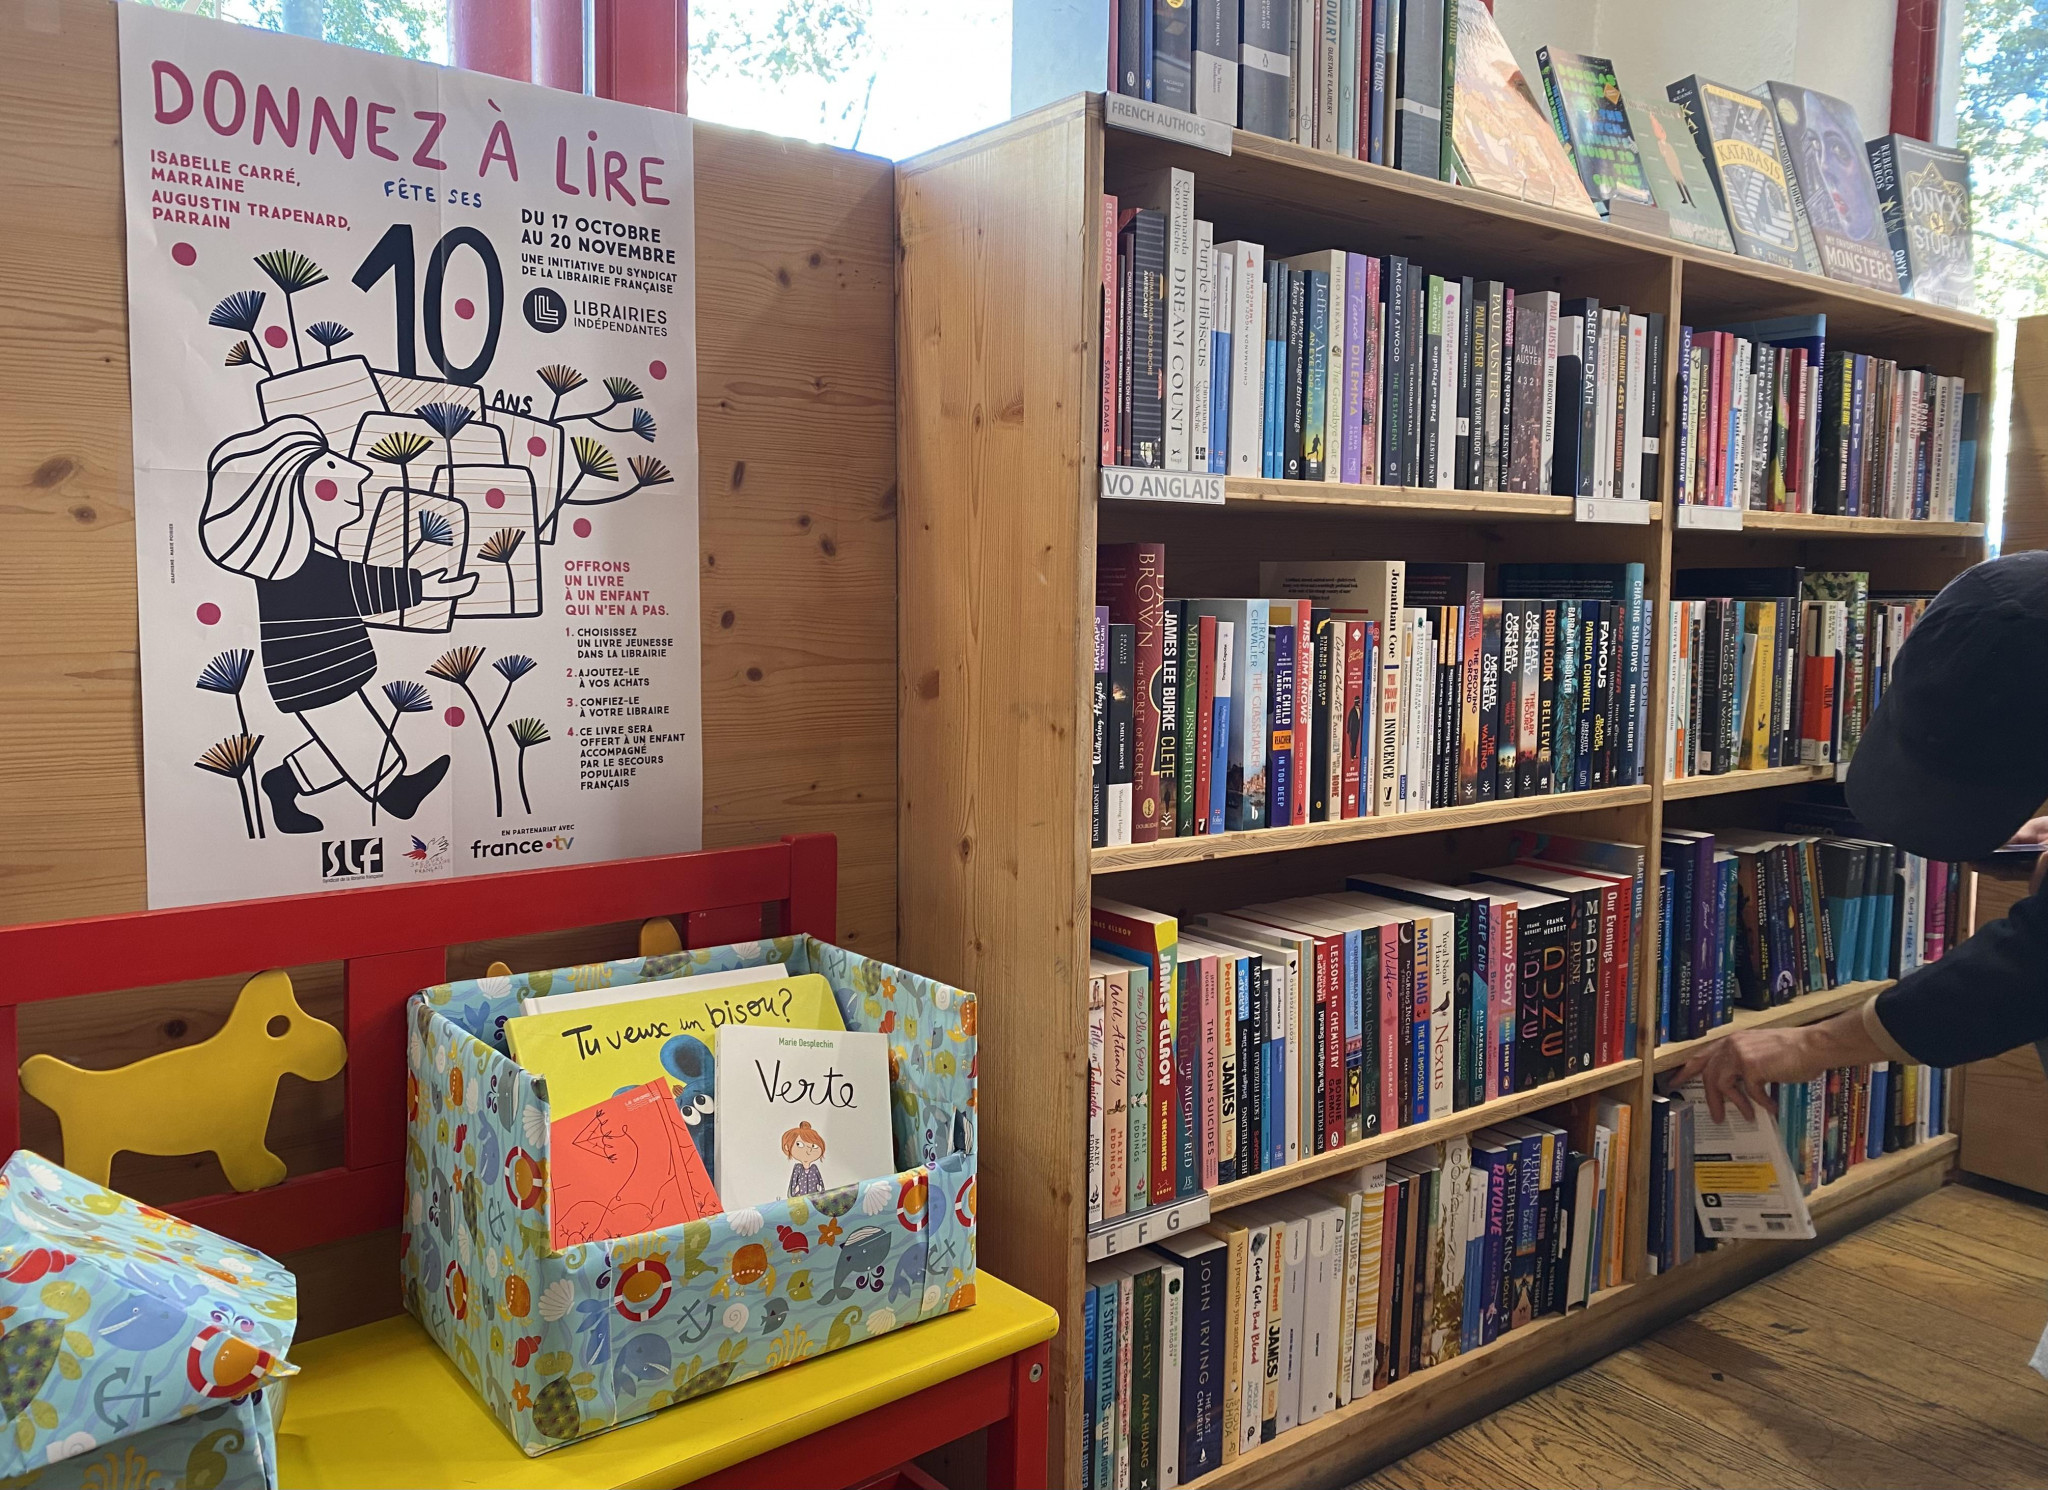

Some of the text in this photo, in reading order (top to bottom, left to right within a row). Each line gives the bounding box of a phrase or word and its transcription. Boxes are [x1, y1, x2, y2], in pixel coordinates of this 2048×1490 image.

[151, 60, 447, 173] DONNEZ
[478, 99, 518, 182] À
[1111, 101, 1206, 137] FRENCH AUTHORS
[150, 149, 301, 187] ISABELLE CARRÉ,
[151, 167, 244, 193] MARRAINE
[1717, 144, 1781, 180] KATABASIS
[1871, 150, 1884, 190] YARROS
[1880, 143, 1895, 191] REBECCA
[152, 190, 351, 231] AUGUSTIN TRAPENARD,
[384, 177, 483, 209] FÊTE SES
[153, 207, 230, 229] PARRAIN
[522, 209, 661, 243] DU 17 OCTOBRE
[1173, 213, 1181, 254] Adichie
[1182, 181, 1190, 256] Chimamanda
[522, 229, 676, 264] AU 20 NOVEMBRE
[1824, 245, 1893, 282] MONSTERS
[522, 253, 677, 282] UNE INITIATIVE DU SYNDICAT
[522, 266, 673, 294] DE LA LIBRAIRIE FRANÇAISE
[351, 223, 504, 385] 10
[574, 300, 667, 324] LIBRAIRIES
[1197, 238, 1211, 368] Purple Hibiscus
[574, 318, 667, 337] INDÉPENDANTES
[1314, 277, 1327, 391] Jeffrey Archer
[1474, 305, 1484, 368] PAUL AUSTER
[1586, 309, 1597, 344] SLEEP
[1170, 267, 1186, 436] DREAM COUNT
[491, 389, 532, 417] ANS
[1584, 364, 1595, 406] DEATH
[1105, 474, 1220, 501] VO ANGLAIS
[1588, 504, 1595, 519] B
[564, 561, 630, 572] OFFRONS
[565, 575, 624, 586] UN LIVRE
[565, 587, 650, 601] À UN ENFANT
[565, 605, 669, 616] QUI N'EN A PAS.
[1135, 553, 1156, 648] BROWN
[1856, 581, 1866, 630] MAGGIE
[566, 627, 637, 637] 1. CHOISISSEZ
[1389, 569, 1400, 659] Jonathan Coe
[577, 638, 673, 647] UN LIVRE JEUNESSE
[578, 649, 666, 658] DANS LA LIBRAIRIE
[1503, 612, 1513, 675] CONNELLY
[1511, 616, 1520, 671] MICHAEL
[1543, 609, 1556, 682] ROBIN COOK
[1597, 621, 1609, 689] FAMOUS
[579, 668, 640, 677] AJOUTEZ-LE
[579, 677, 650, 688] À VOS ACHATS
[1300, 619, 1310, 725] MISS KIM KNOWS
[1581, 621, 1593, 714] PATRICIA CORNWELL
[580, 697, 640, 706] CONFIEZ-LE
[580, 706, 669, 717] À VOTRE LIBRAIRE
[1160, 609, 1178, 779] JAMES LEE BURKE CLETE
[1282, 670, 1292, 725] LEE CHILD
[1824, 684, 1833, 709] JULIA
[580, 728, 592, 736] CE
[596, 726, 624, 735] LIVRE
[628, 725, 653, 734] SERA
[580, 734, 685, 747] OFFERT À UN ENFANT
[1274, 734, 1292, 745] REACHER
[580, 744, 647, 758] ACCOMPAGNÉ
[581, 756, 664, 768] PAR LE SECOURS
[1382, 719, 1396, 780] INNOCENCE
[581, 768, 636, 779] POPULAIRE
[581, 779, 629, 790] FRANÇAIS
[513, 826, 556, 836] PARTENARIAT
[558, 824, 575, 832] AVEC
[1543, 924, 1567, 936] HERBERT
[1546, 916, 1564, 926] FRANK
[1604, 892, 1618, 964] Our Evenings
[1502, 908, 1517, 1006] Funny Story
[1583, 900, 1598, 995] MEDEA
[1330, 944, 1338, 992] LESSONS
[1416, 927, 1428, 1005] MATT HAIG
[1158, 953, 1172, 1087] JAMES ELLROY
[1223, 962, 1233, 1047] Percival Everett
[562, 988, 793, 1061] Tu veux un bisou?
[1329, 1011, 1338, 1069] CHEMISTRY
[778, 1037, 834, 1050] Marie Desplechin
[1434, 1022, 1450, 1090] Nexus
[755, 1059, 858, 1109] Verte
[1222, 1061, 1236, 1117] JAMES
[1490, 1163, 1505, 1236] REVOLVE
[1138, 1222, 1148, 1244] F
[1167, 1210, 1180, 1232] G
[1503, 1167, 1518, 1273] STEPHEN KING
[1106, 1233, 1117, 1256] E
[1199, 1260, 1211, 1386] JOHN IRVING
